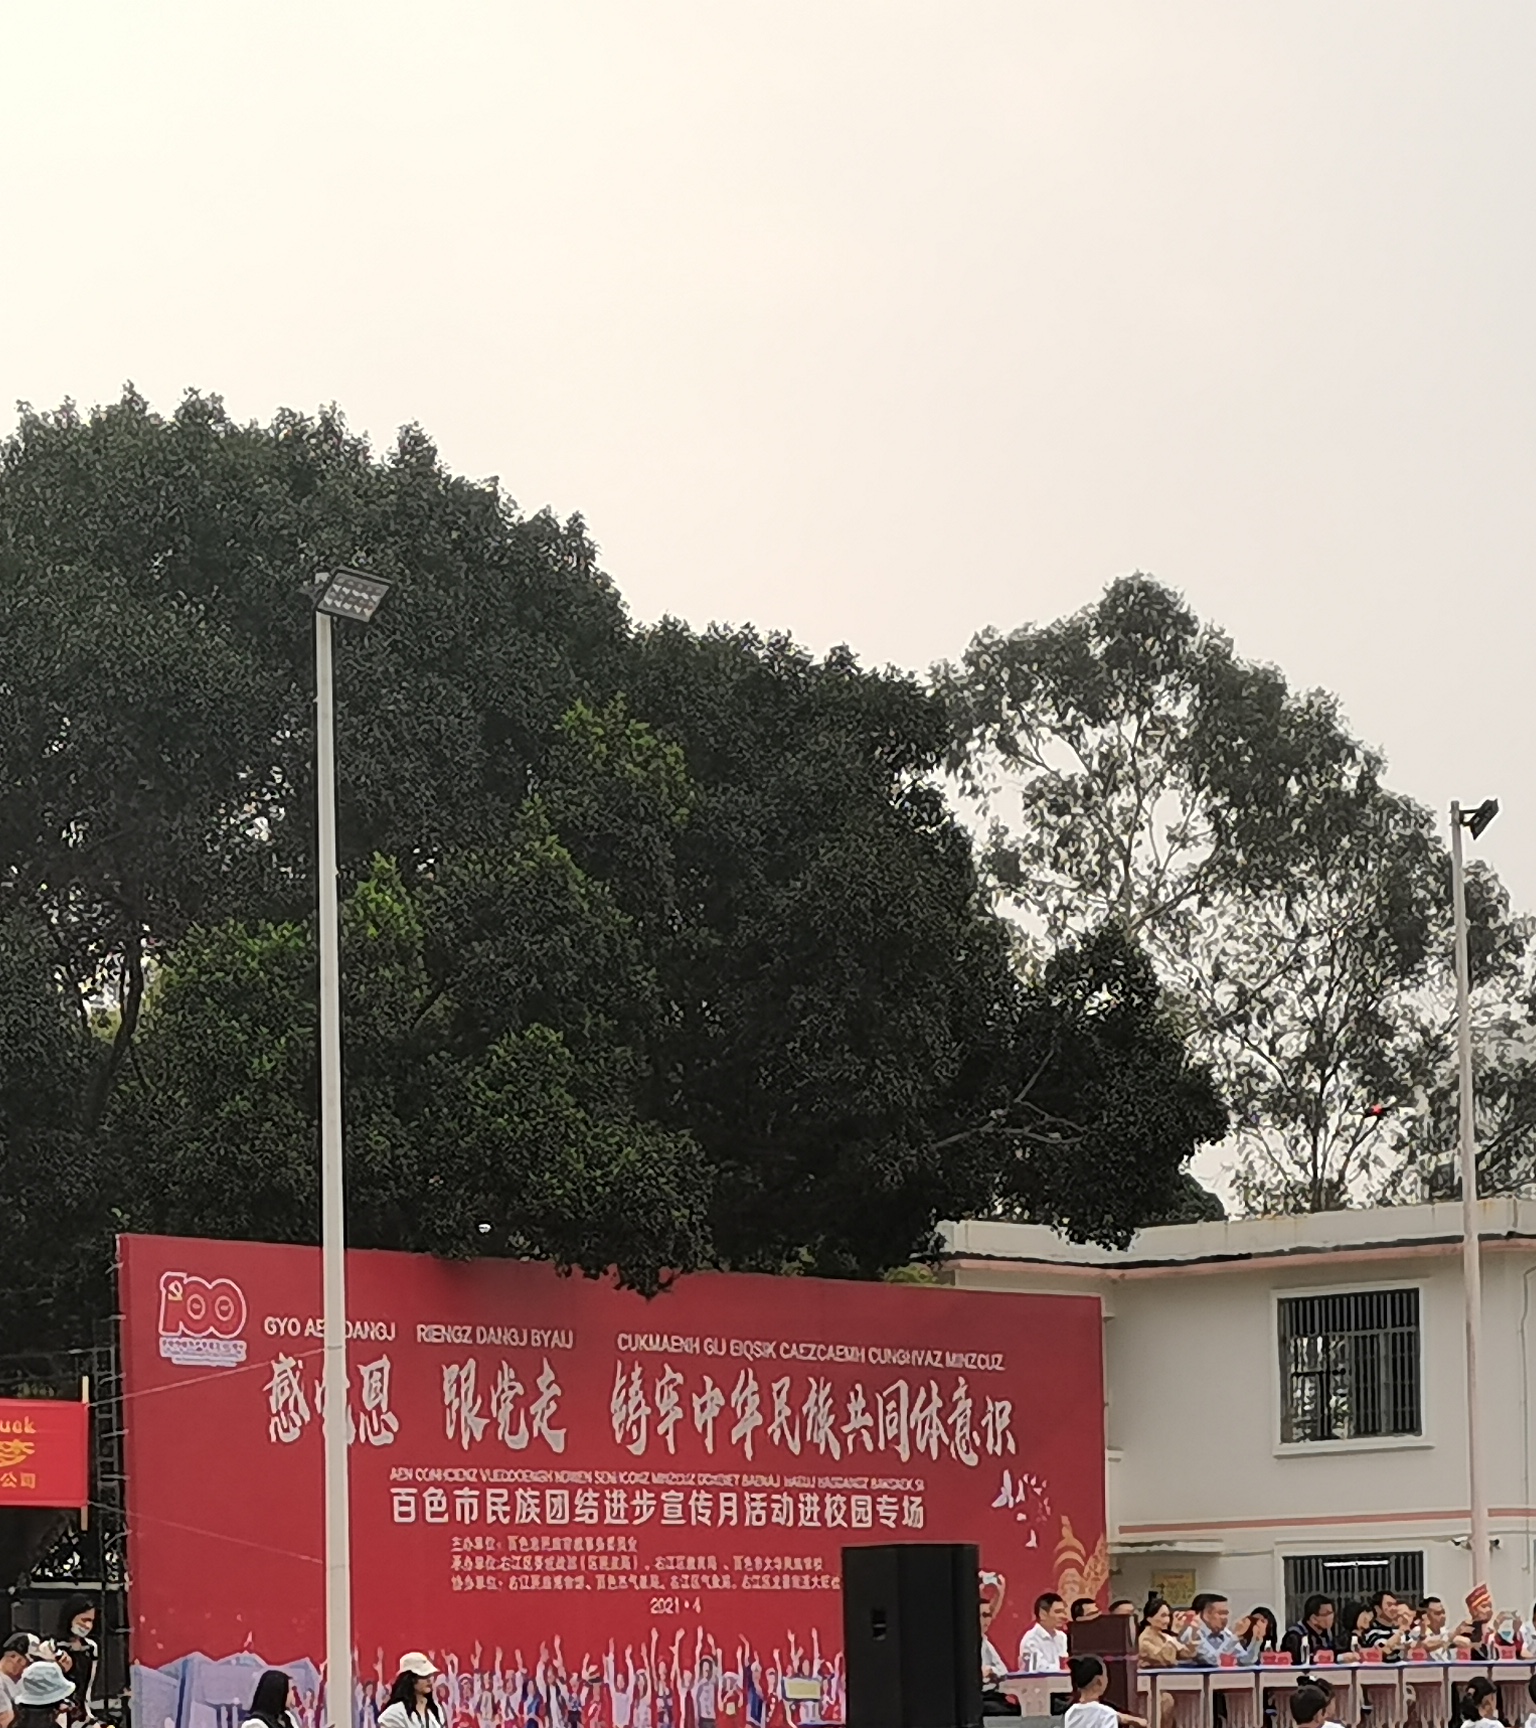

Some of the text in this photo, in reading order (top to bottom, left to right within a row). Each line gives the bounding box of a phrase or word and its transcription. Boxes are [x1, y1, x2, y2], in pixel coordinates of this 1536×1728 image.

[264, 1316, 301, 1337] GYO
[476, 1326, 528, 1346] DANGJ
[263, 1352, 1017, 1467] 感恩 跟党走 铸牢中华民族共同体意识
[390, 1486, 925, 1529] 百色市民族团结进步宣传月活动进校园专场
